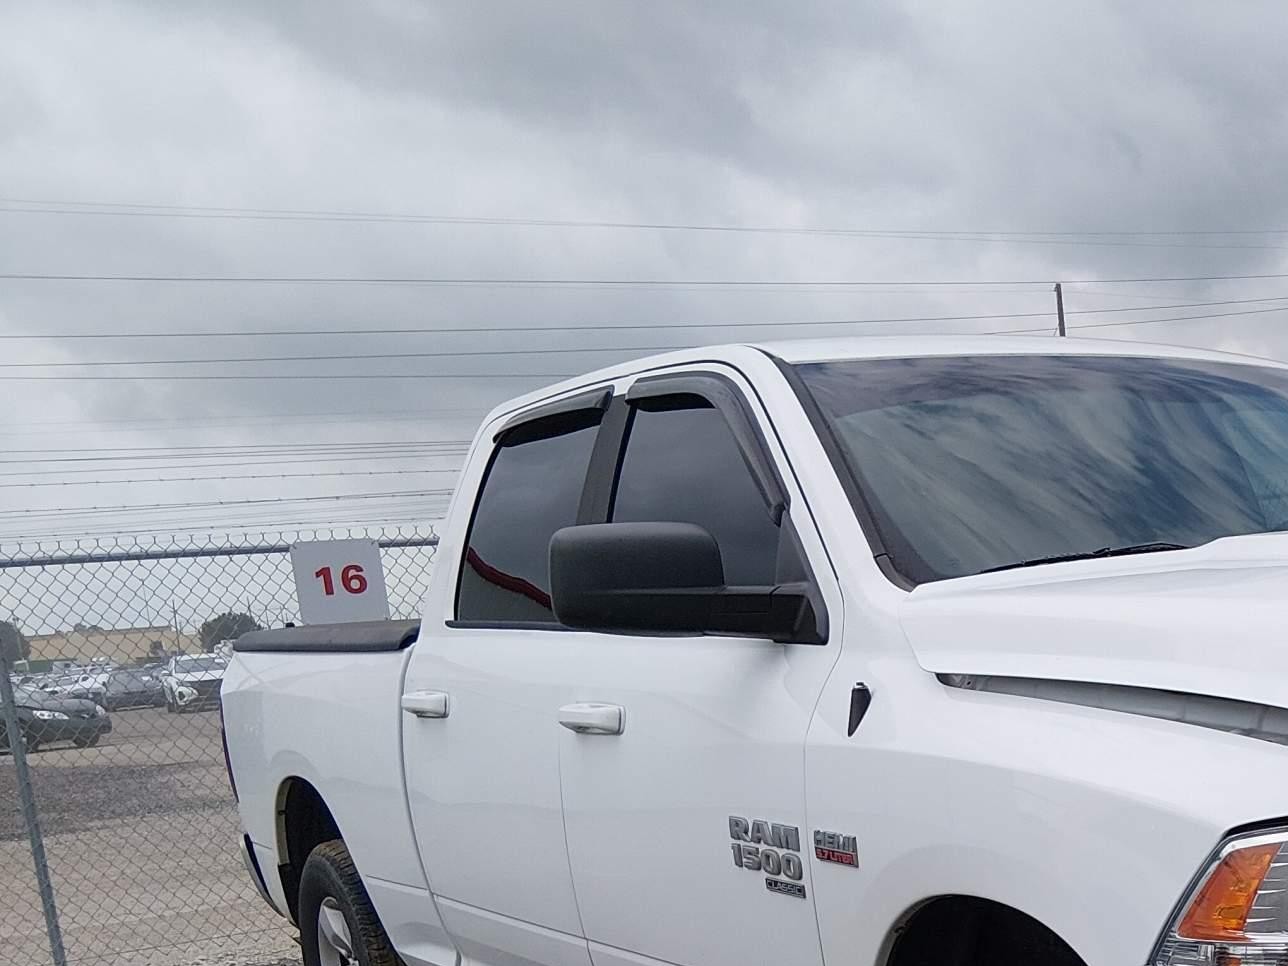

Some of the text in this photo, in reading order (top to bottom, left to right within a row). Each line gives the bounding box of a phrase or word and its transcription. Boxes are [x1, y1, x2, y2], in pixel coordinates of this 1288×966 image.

[315, 564, 368, 596] 16
[728, 815, 801, 852] RAM
[814, 829, 857, 853] HEMI
[731, 843, 804, 881] 1500
[766, 879, 805, 897] CLASSIC
